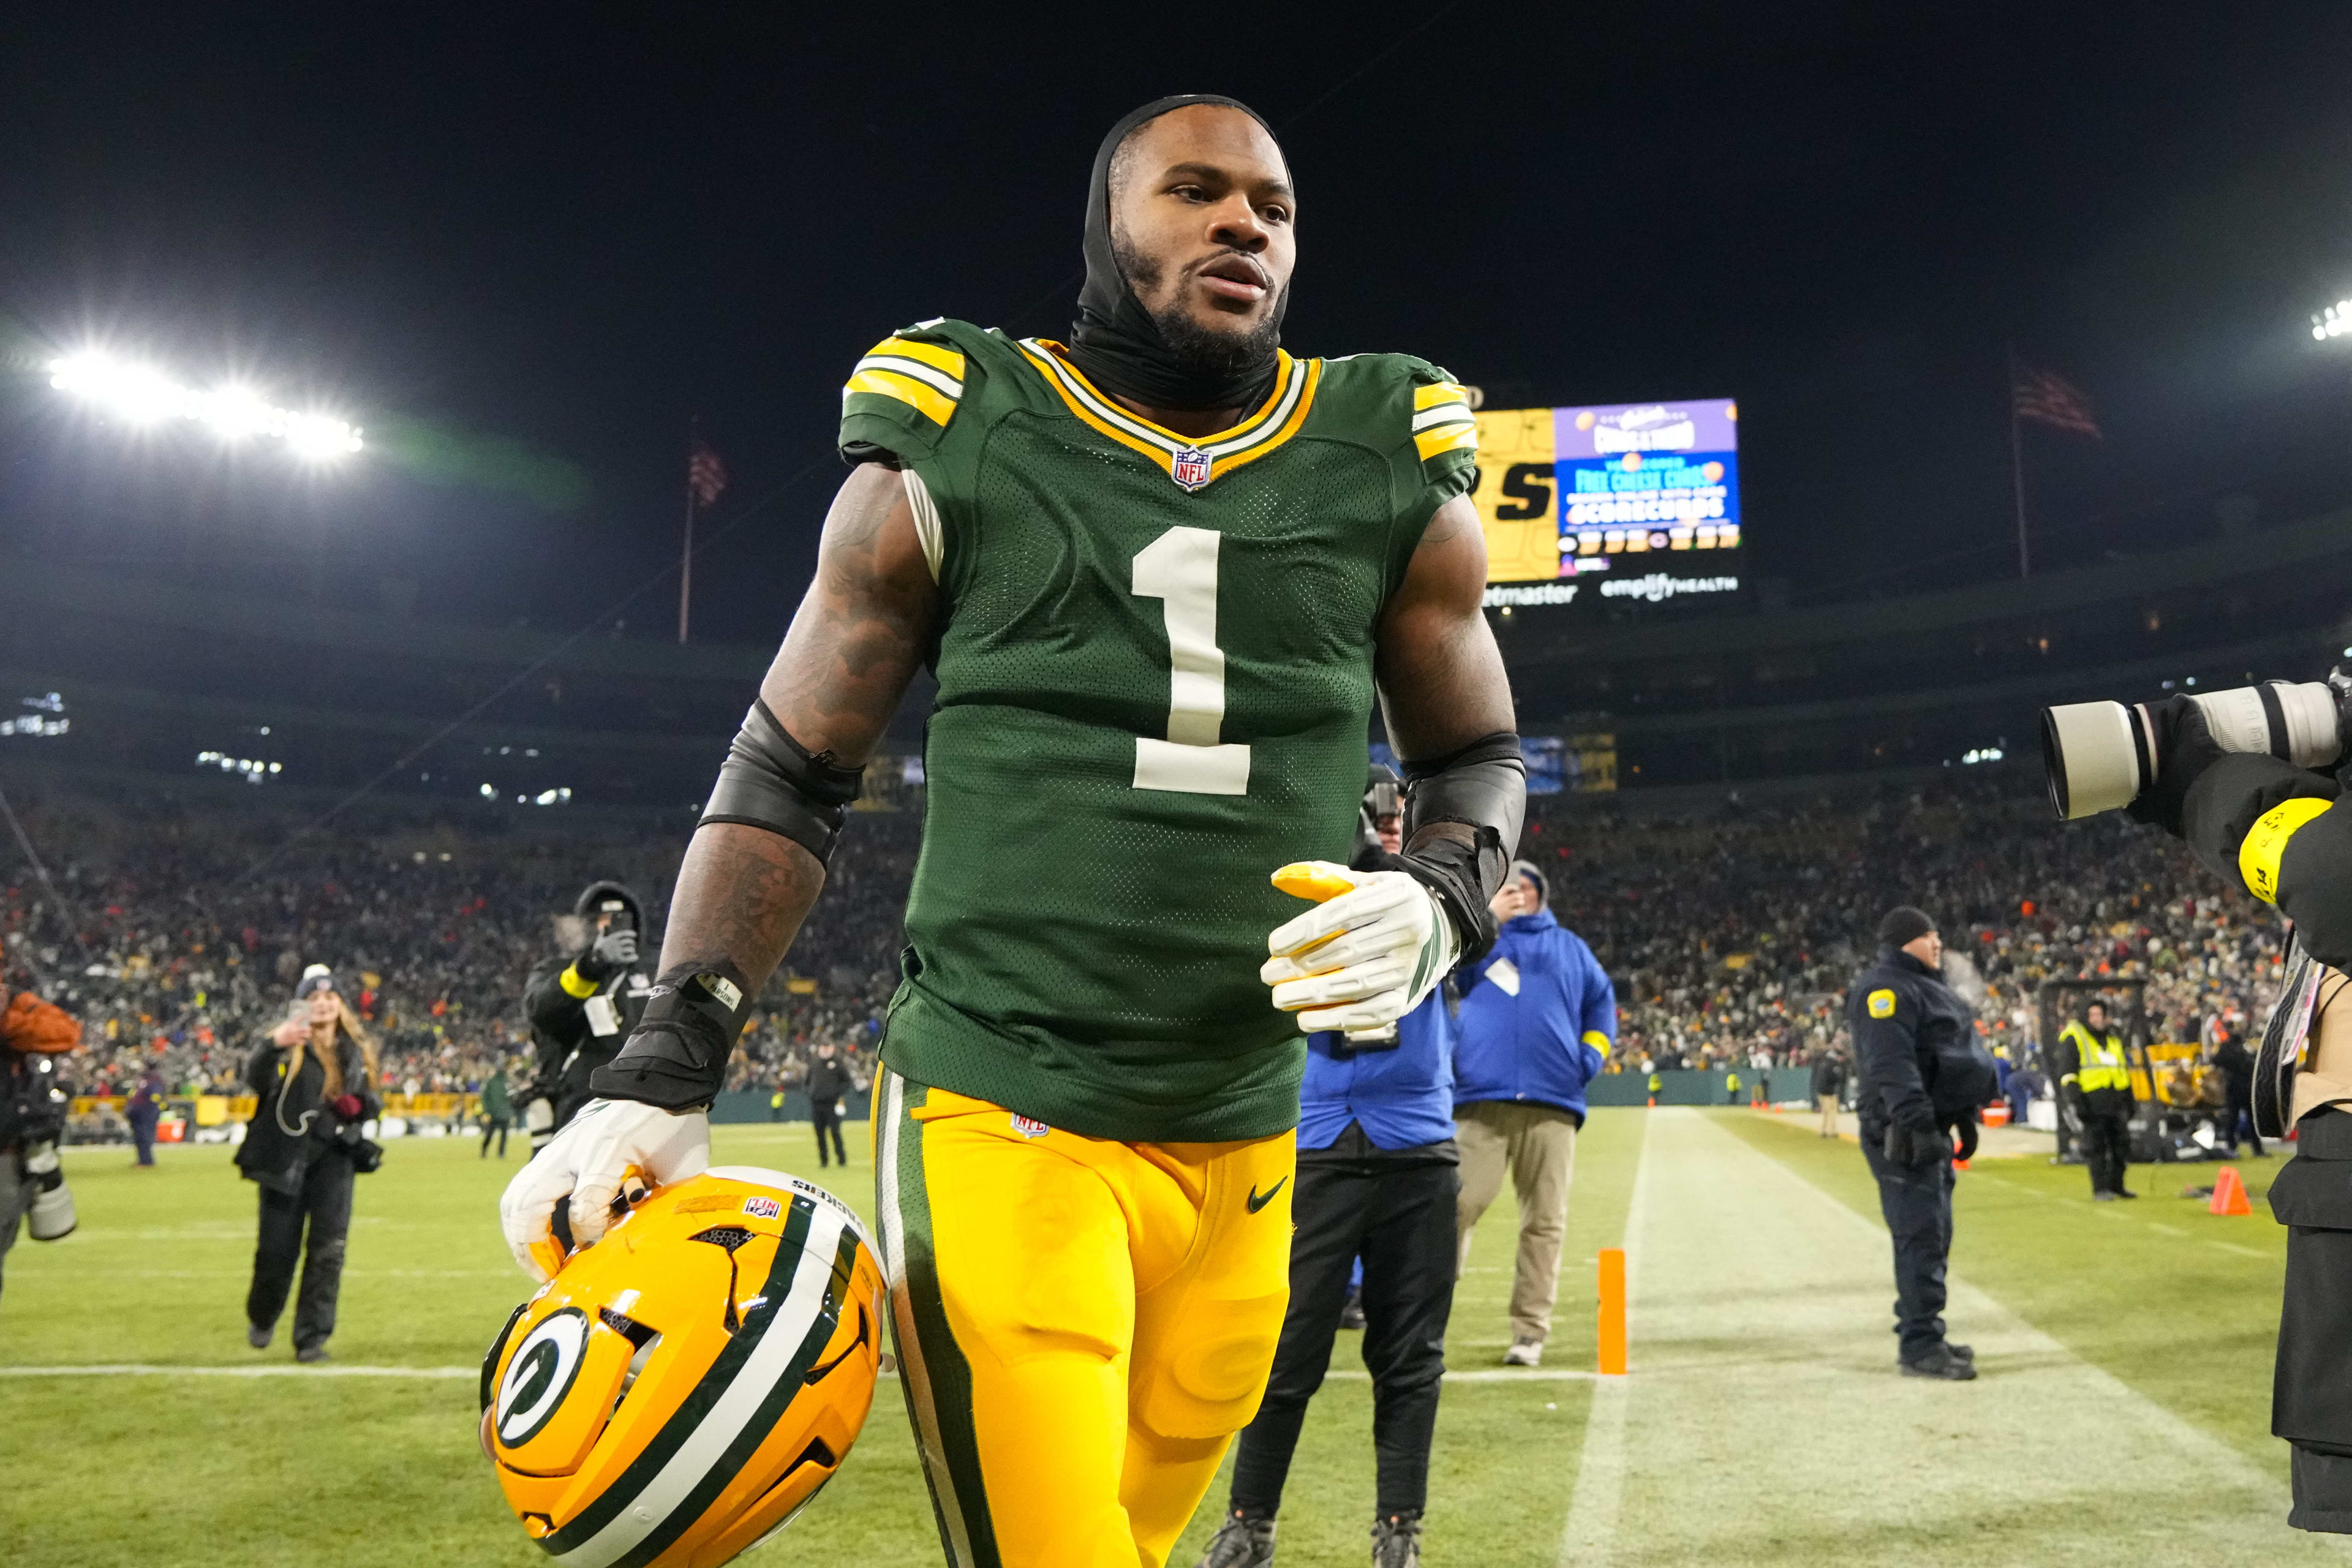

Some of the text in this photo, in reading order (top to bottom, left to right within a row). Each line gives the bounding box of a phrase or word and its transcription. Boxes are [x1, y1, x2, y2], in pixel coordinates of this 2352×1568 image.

[1178, 463, 1204, 483] NFL
[1464, 462, 1555, 521] S
[1131, 526, 1251, 795] 1
[710, 983, 734, 1006] PARSONS
[752, 1198, 777, 1210] NFL
[497, 1311, 586, 1442] G
